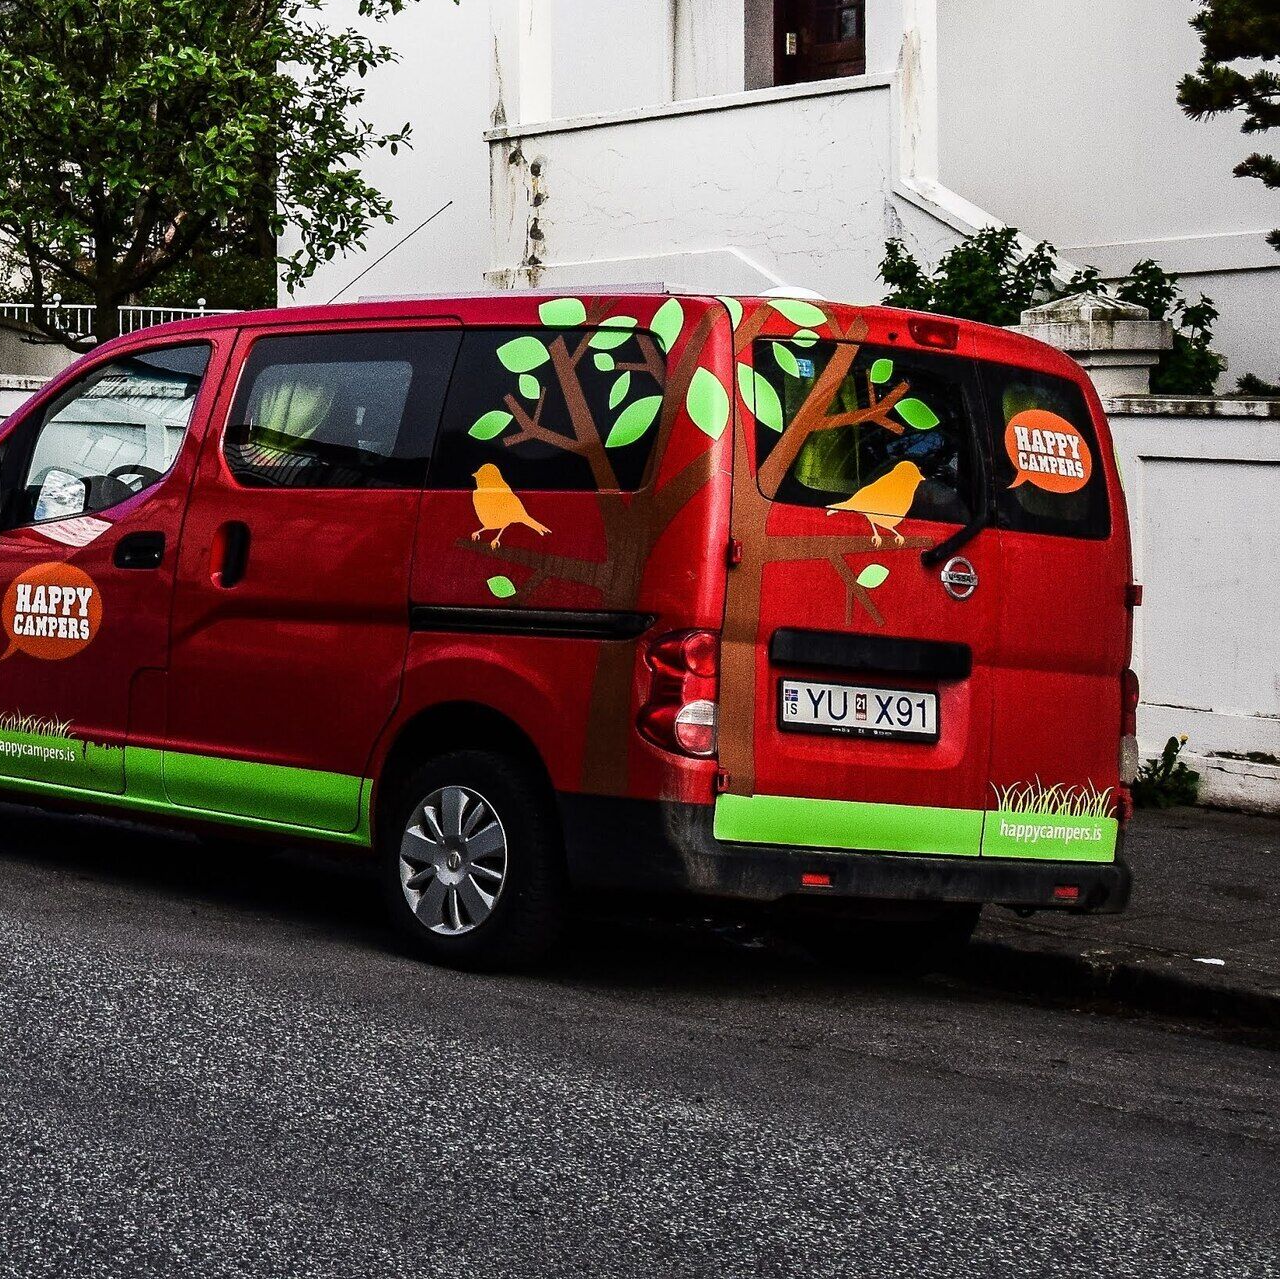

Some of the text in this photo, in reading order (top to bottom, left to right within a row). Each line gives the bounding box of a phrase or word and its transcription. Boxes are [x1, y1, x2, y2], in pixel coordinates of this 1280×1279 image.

[1013, 425, 1080, 460] HAPPY
[1018, 452, 1084, 479] CAMPERS
[15, 584, 93, 617] HAPPY
[13, 613, 90, 640] CAMPERS
[785, 688, 927, 728] IS YU X91
[856, 697, 866, 710] 21
[1000, 818, 1102, 845] happycampers.is
